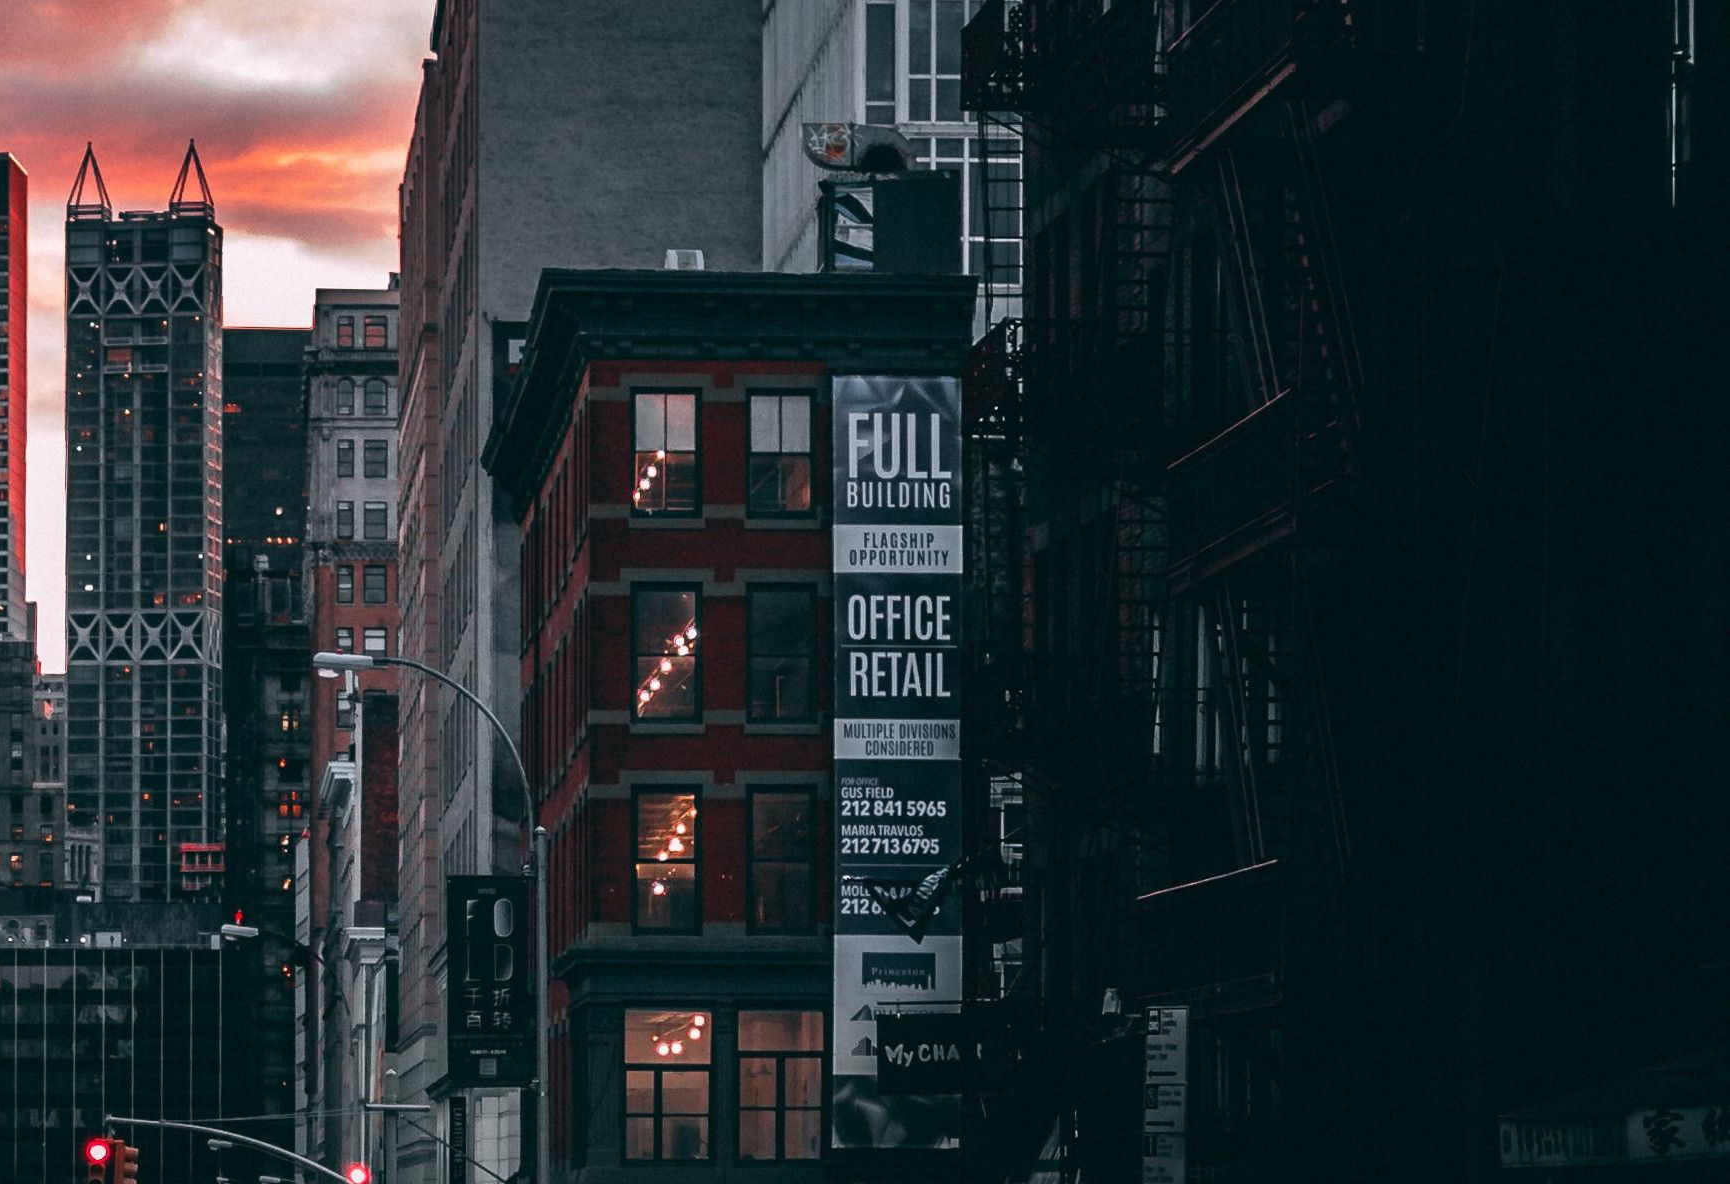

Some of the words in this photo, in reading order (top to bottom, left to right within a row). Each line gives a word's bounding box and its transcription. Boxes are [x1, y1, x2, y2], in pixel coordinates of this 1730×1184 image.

[848, 412, 952, 479] FULL
[847, 481, 951, 508] BUILDING
[863, 532, 935, 549] FLAGSHIP
[849, 549, 949, 566] OPPORTUNITY
[848, 594, 951, 641] OFFICE
[849, 651, 952, 697] RETAIL
[843, 723, 895, 739] MULTIPLE
[899, 723, 957, 740] DIVISIONS
[864, 739, 935, 756] CONSIDERED
[840, 786, 864, 799] GUS
[865, 786, 895, 799] FIELD
[840, 799, 871, 817] 212
[873, 800, 903, 817] 841
[906, 800, 947, 818] 5965
[840, 824, 877, 836] MARIA
[877, 824, 924, 837] TRAVLOS
[840, 837, 870, 854] 212
[871, 838, 901, 854] 713
[901, 838, 940, 855] 6795
